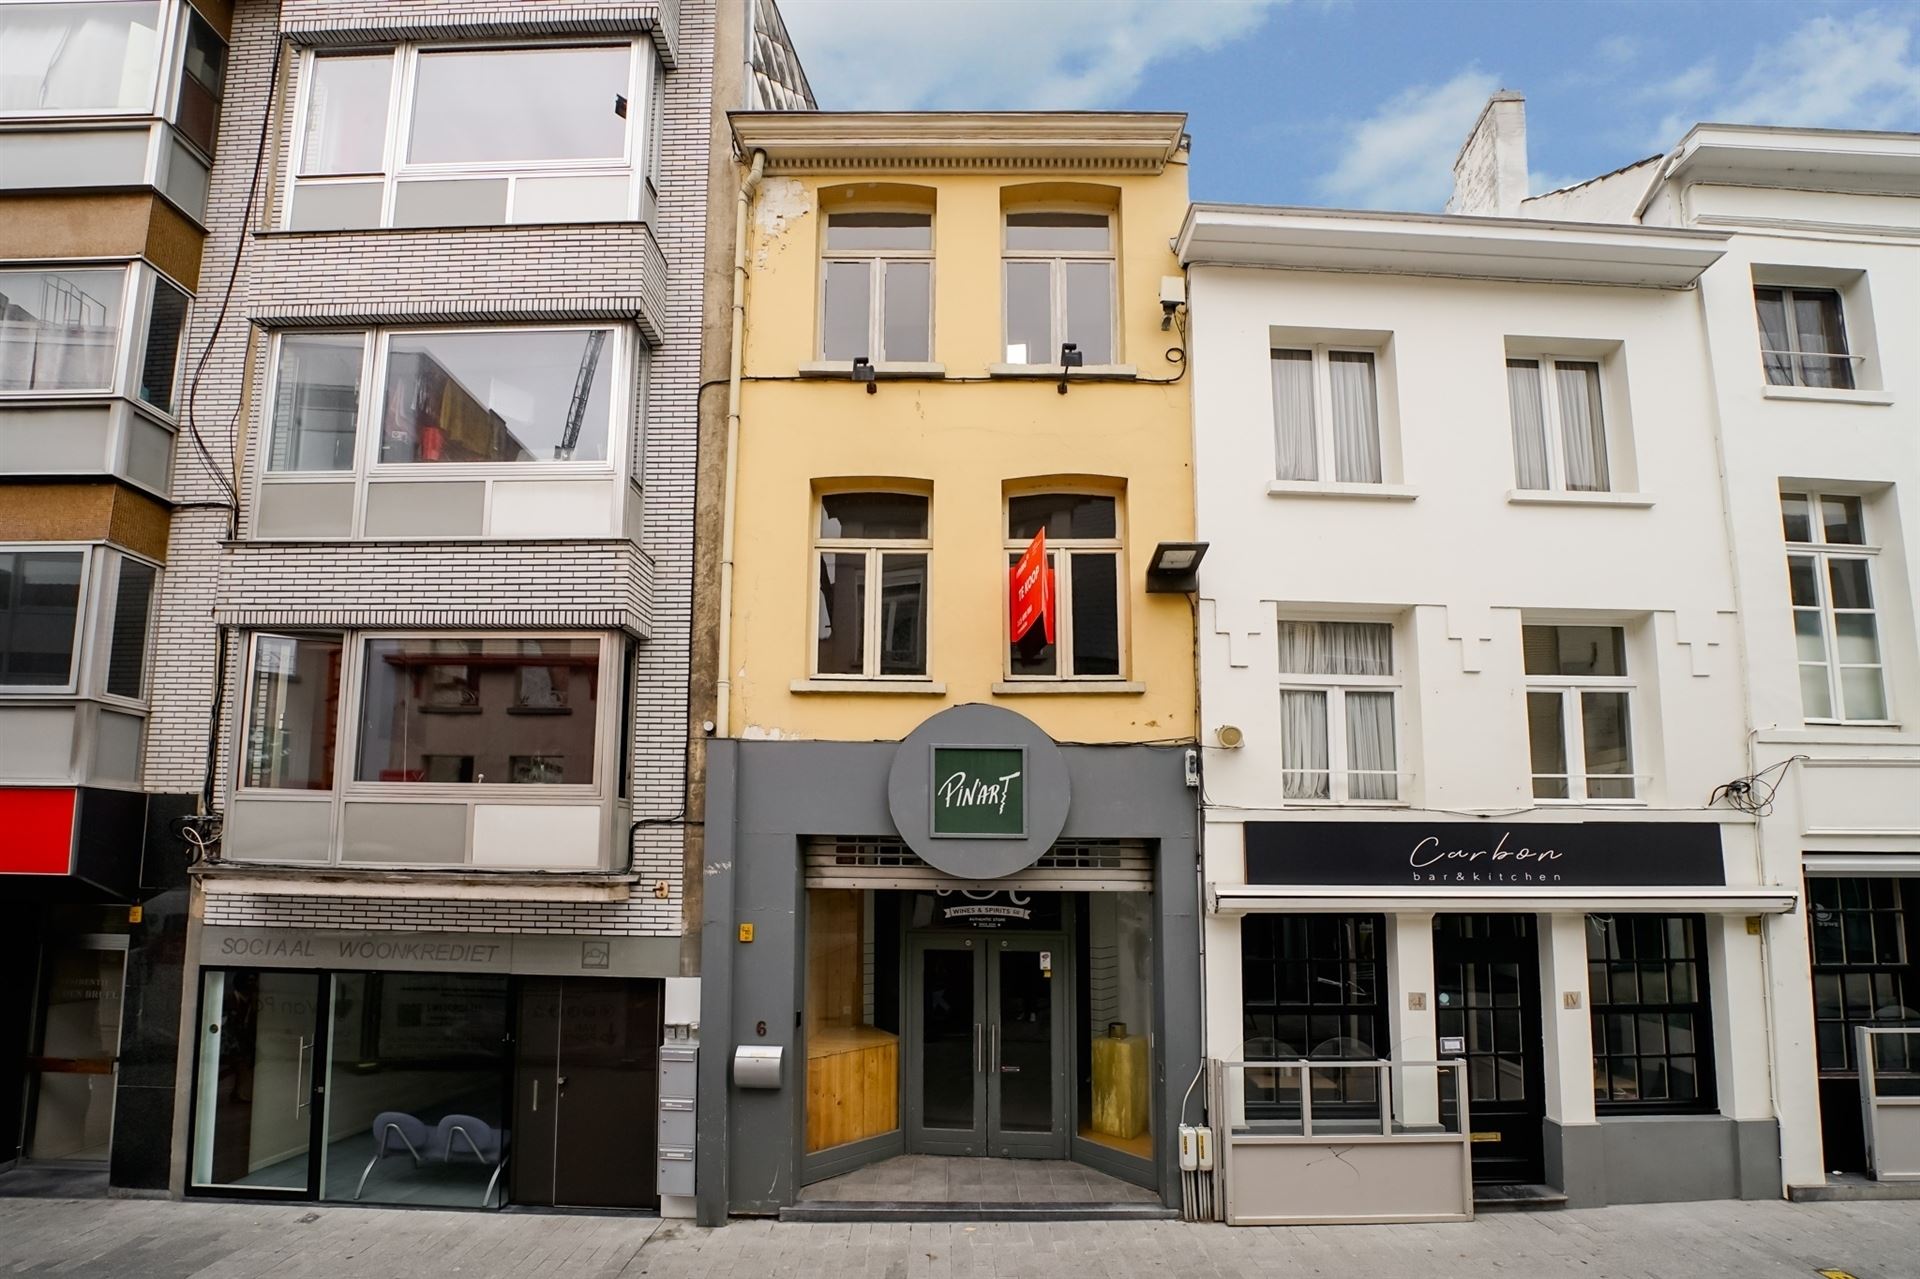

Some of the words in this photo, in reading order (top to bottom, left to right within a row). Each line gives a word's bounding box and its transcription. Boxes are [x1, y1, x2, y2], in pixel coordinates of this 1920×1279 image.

[1018, 585, 1025, 602] TE
[1024, 564, 1040, 595] KOOP
[1409, 832, 1563, 868] Carbon
[952, 907, 976, 915] WINES
[984, 907, 1011, 915] SPIRITS
[221, 937, 315, 958] SOCIAAL
[338, 941, 500, 963] WOONKREDIET
[1565, 994, 1579, 1007] IV
[756, 1020, 767, 1037] 6
